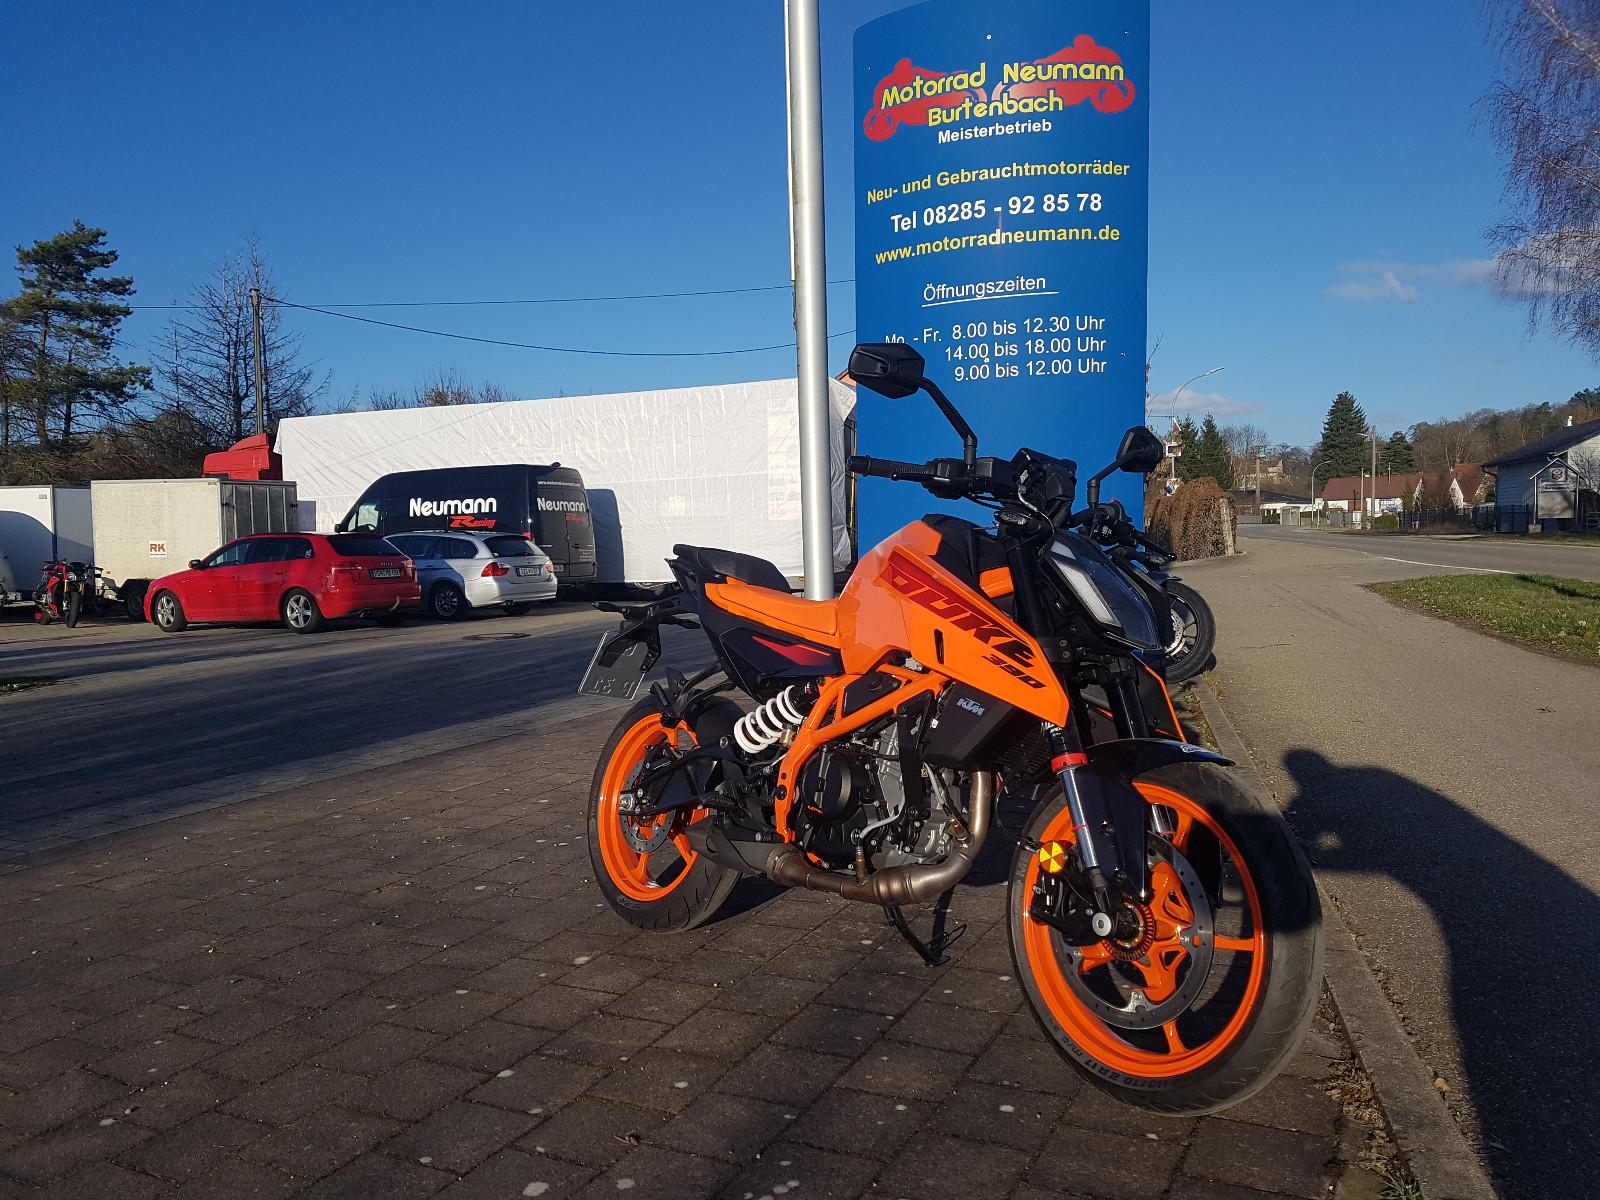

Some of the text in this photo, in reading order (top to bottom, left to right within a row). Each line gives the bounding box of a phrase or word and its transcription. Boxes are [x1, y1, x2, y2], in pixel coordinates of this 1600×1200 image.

[881, 62, 1124, 110] Motorrad Neumann
[928, 90, 1064, 127] Burtenbach
[938, 119, 1052, 144] Meisterbetrieb
[867, 160, 1130, 204] Neu- und Gebrauchtmotorräder
[891, 212, 917, 233] Tel
[923, 200, 986, 226] 08285
[1008, 195, 1035, 215] 92
[1043, 194, 1070, 213] 85
[1077, 193, 1102, 212] 78
[875, 225, 1120, 264] www.motorradneumann.de
[923, 274, 1046, 302] Öffnungszeiten
[923, 328, 942, 344] Fr.
[952, 322, 988, 340] 8.00
[993, 319, 1017, 336] bis
[1023, 316, 1070, 334] 12.30
[1076, 315, 1105, 331] Uhr
[945, 337, 1106, 362] 14.00 bis 18.00 Uhr
[954, 358, 1107, 382] 9.00 bis 12.00 Uhr
[409, 497, 497, 517] Neumann
[537, 497, 586, 512] Neumann
[450, 515, 497, 529] Racing
[149, 543, 166, 552] RK
[880, 562, 1036, 668] DUKE
[982, 653, 1047, 689] 390
[956, 697, 985, 717] KTM
